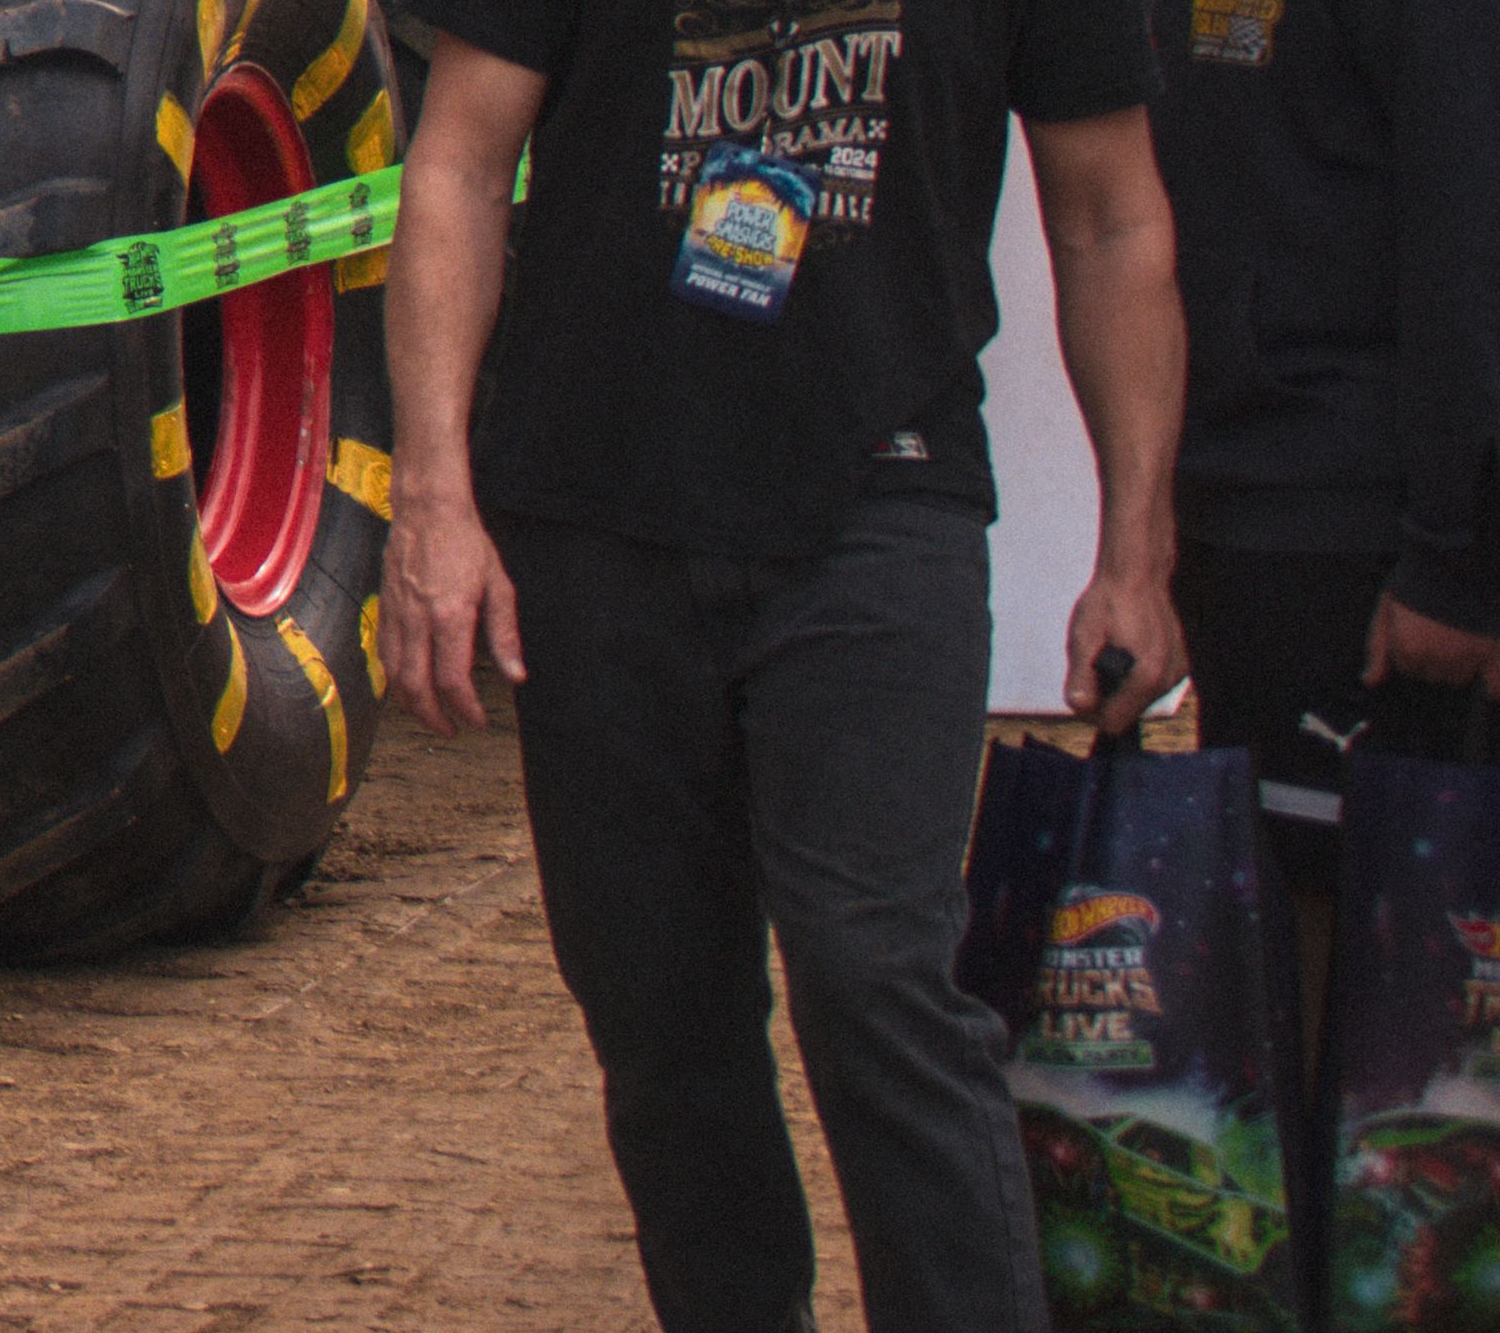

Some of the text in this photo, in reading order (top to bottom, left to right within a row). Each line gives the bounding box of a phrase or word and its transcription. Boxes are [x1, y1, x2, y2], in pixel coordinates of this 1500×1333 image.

[664, 31, 902, 139] MOUNT
[830, 146, 879, 168] 2024
[686, 272, 772, 308] POWER FAN
[1041, 946, 1146, 969] ONSTER
[1040, 968, 1162, 1015] RUCKS
[1042, 1011, 1135, 1040] LIVE
